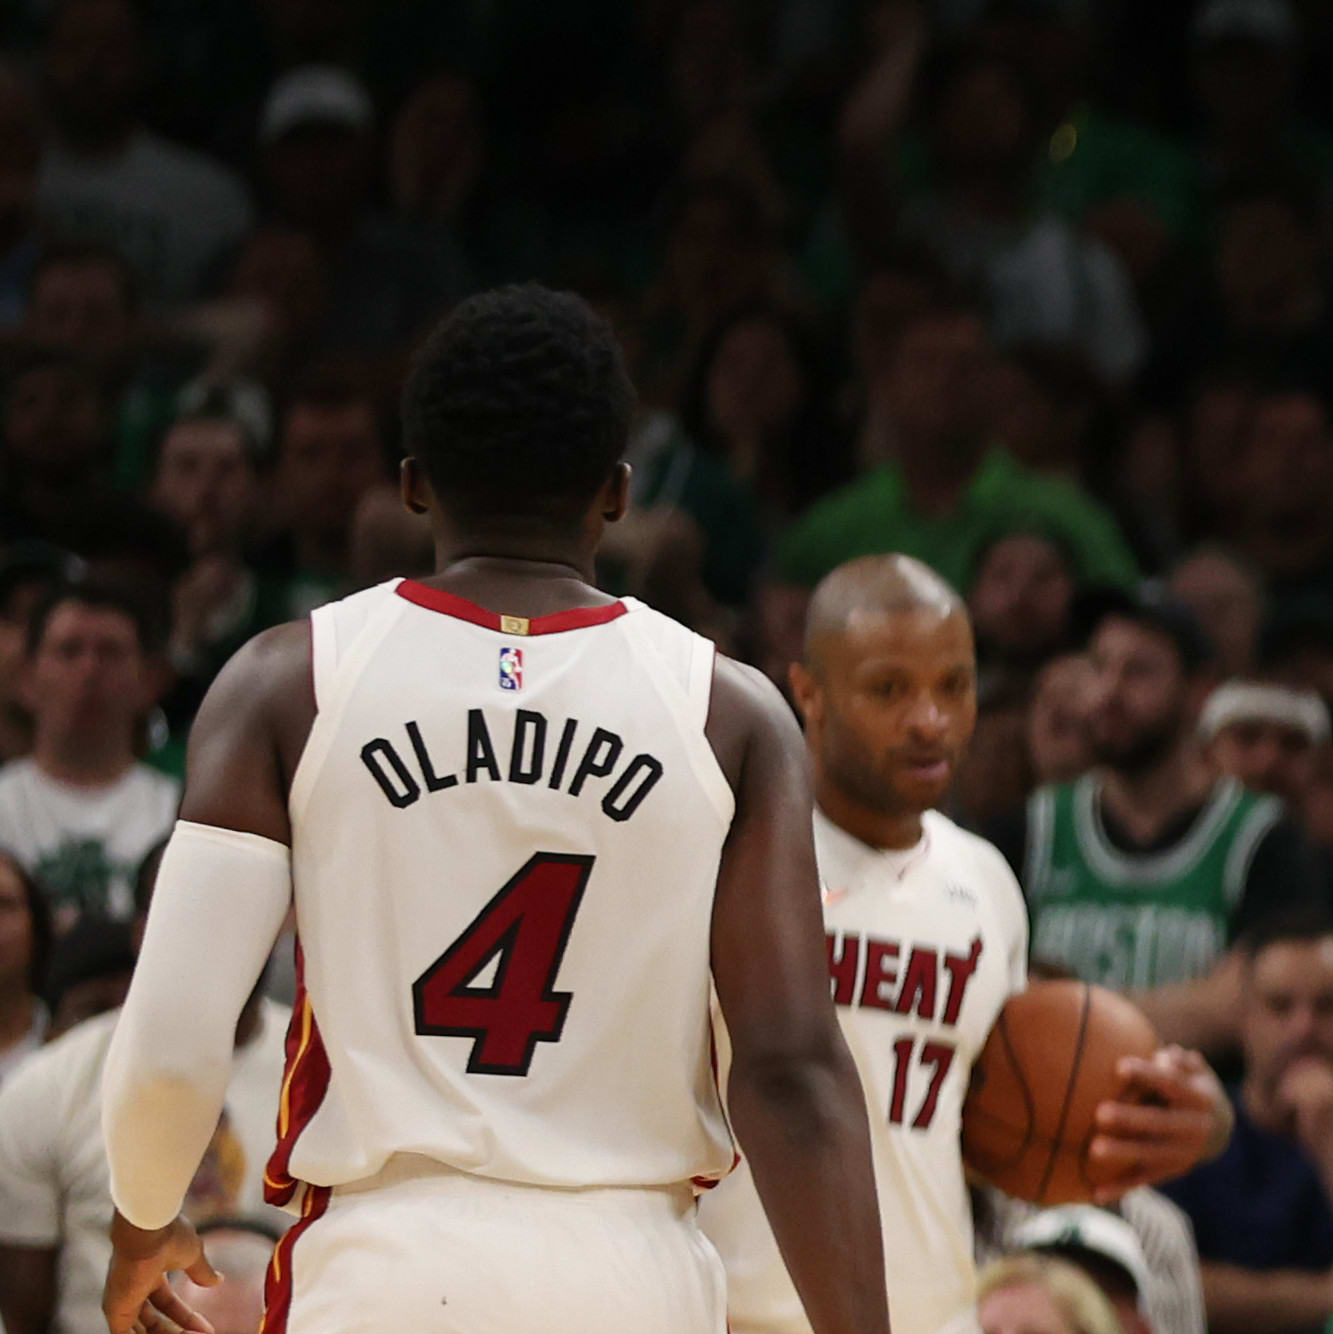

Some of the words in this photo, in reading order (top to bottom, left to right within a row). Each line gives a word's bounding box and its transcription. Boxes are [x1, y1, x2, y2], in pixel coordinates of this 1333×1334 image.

[360, 709, 664, 822] OLADIPO
[412, 851, 597, 1077] 4
[825, 930, 983, 1027] HEAT
[889, 1036, 957, 1131] 17
